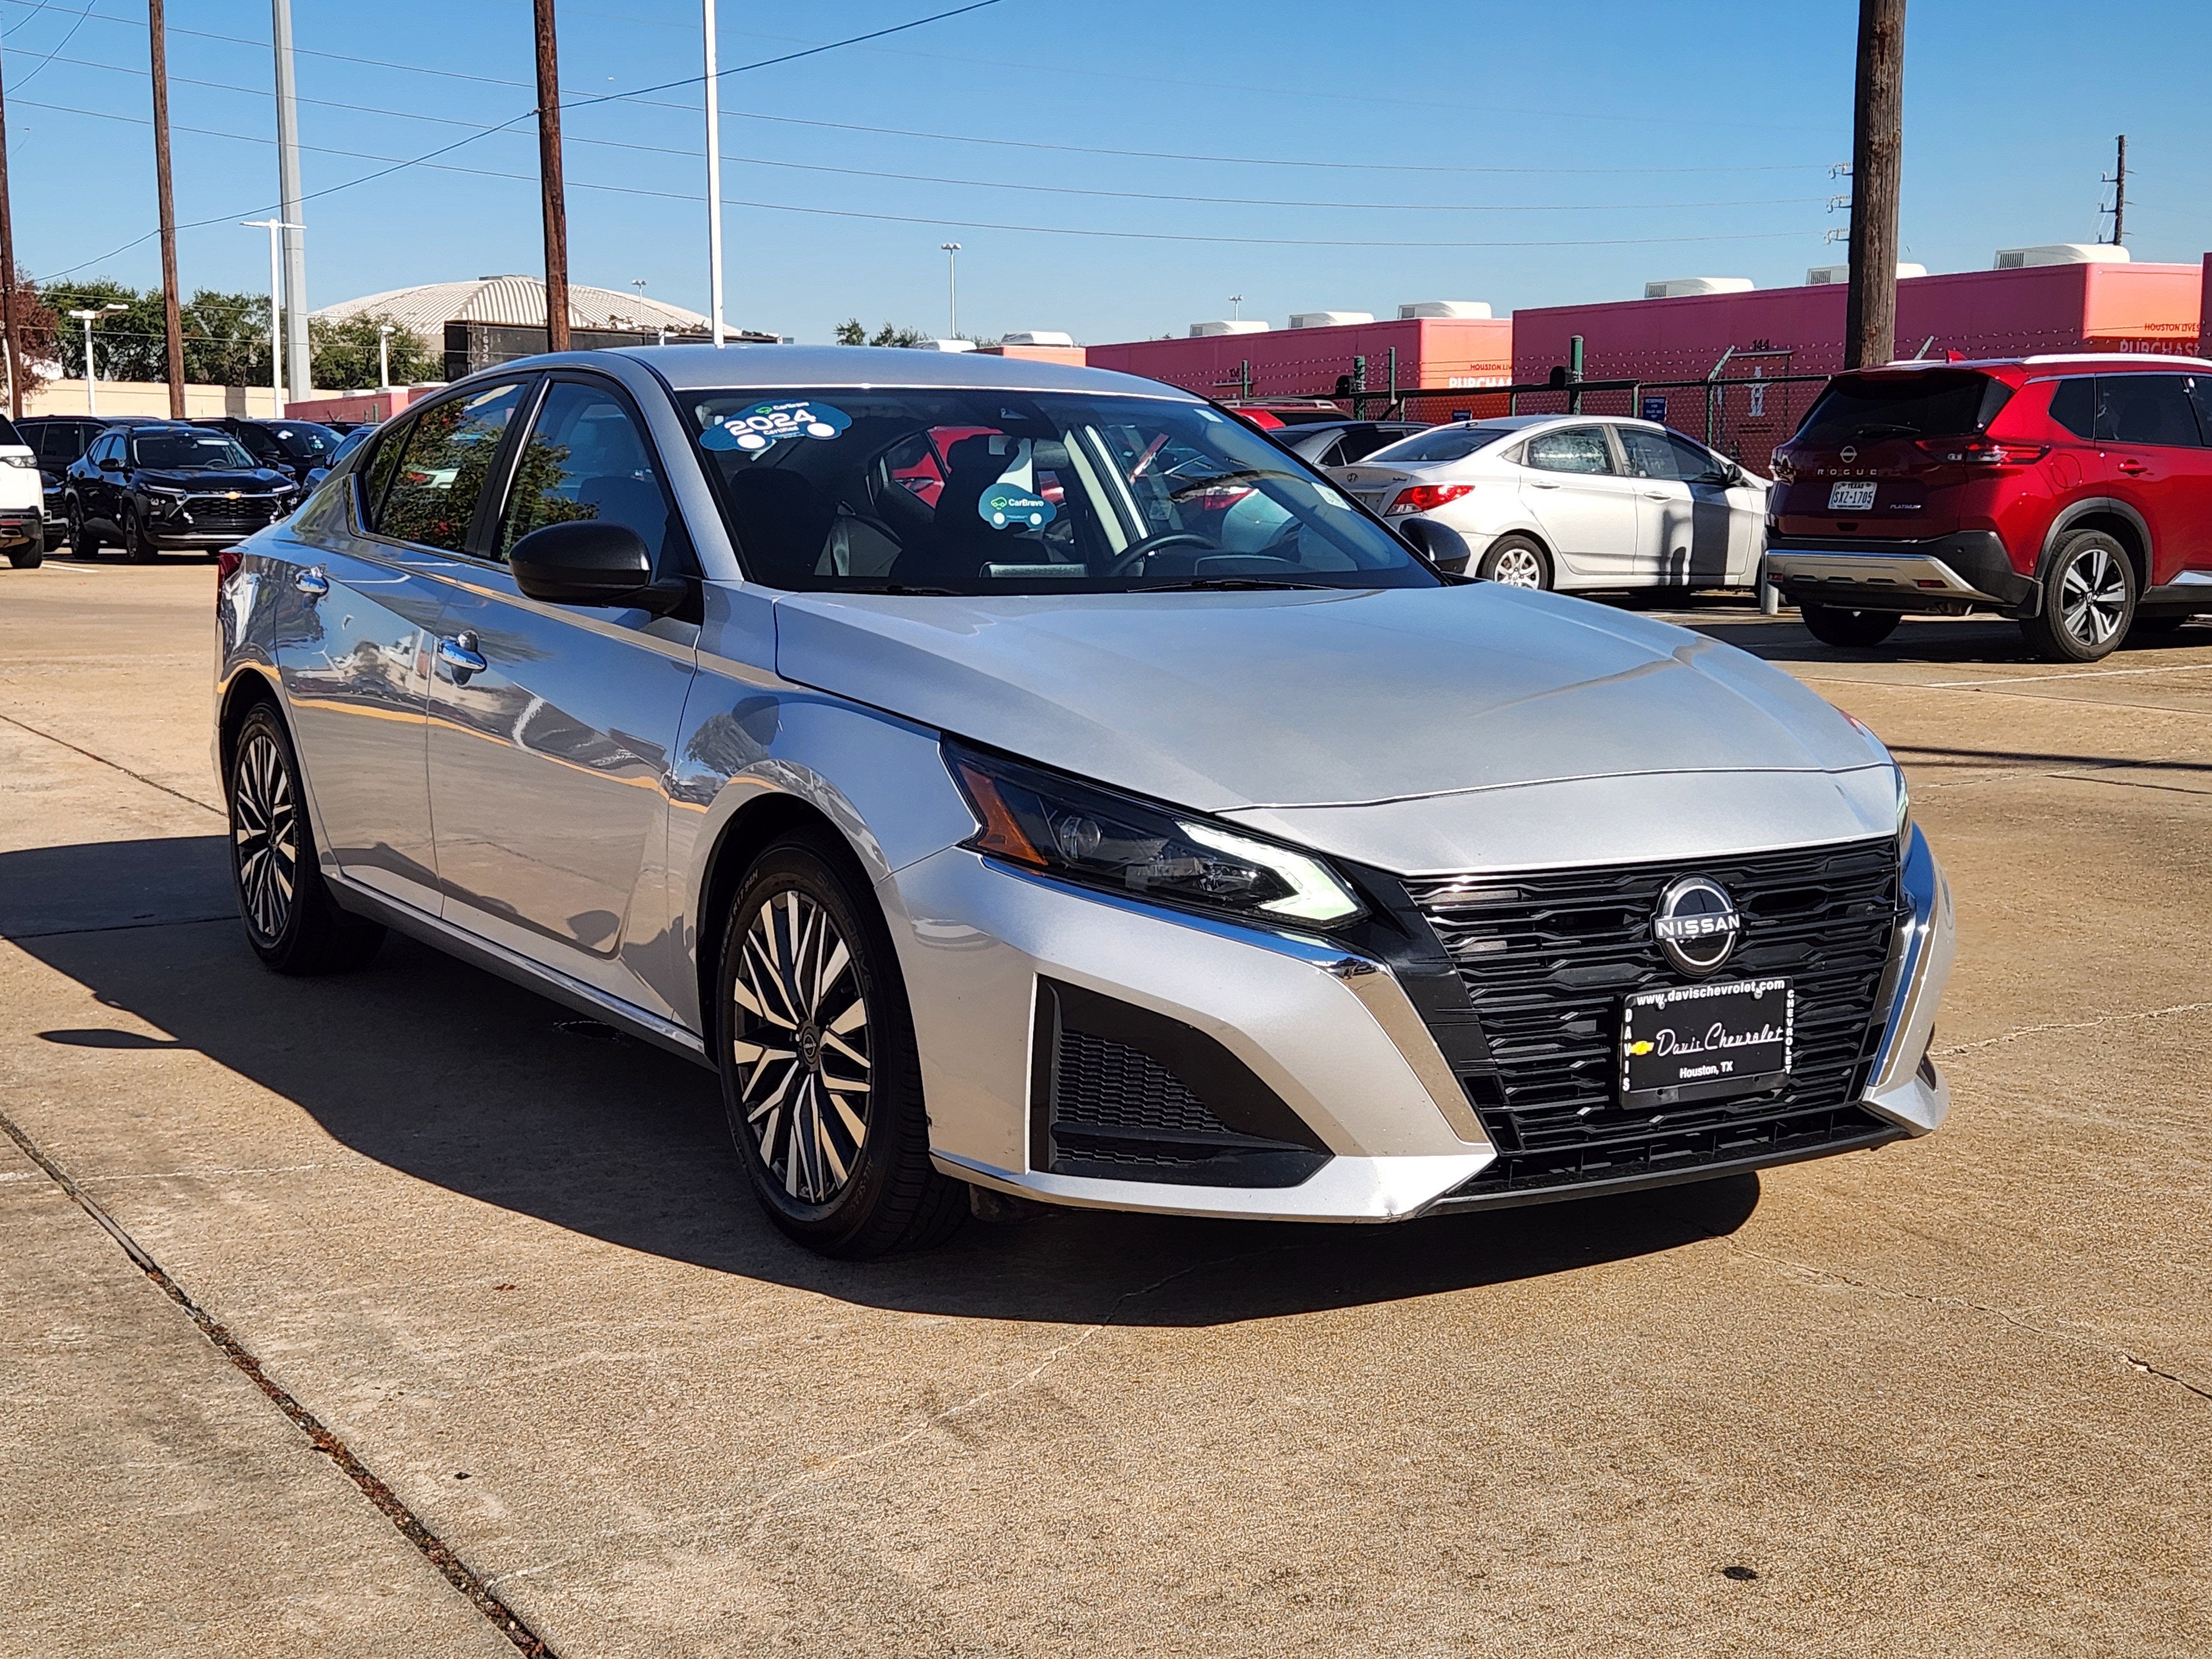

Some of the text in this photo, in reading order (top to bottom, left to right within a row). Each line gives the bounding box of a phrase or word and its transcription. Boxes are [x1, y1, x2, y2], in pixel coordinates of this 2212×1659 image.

[2144, 322, 2179, 331] HOUSTON
[1752, 338, 1770, 351] 144
[724, 409, 817, 436] 2024
[1008, 498, 1044, 507] CarBravo
[1657, 914, 1740, 938] NISSAN
[1637, 979, 1785, 1006] www.davischevrolet.com
[1656, 1022, 1783, 1056] Davis Chevrolet
[1785, 989, 1795, 1075] CHEVROLET
[1623, 1008, 1632, 1092] DAVIS
[1679, 1061, 1733, 1079] Houston, TX
